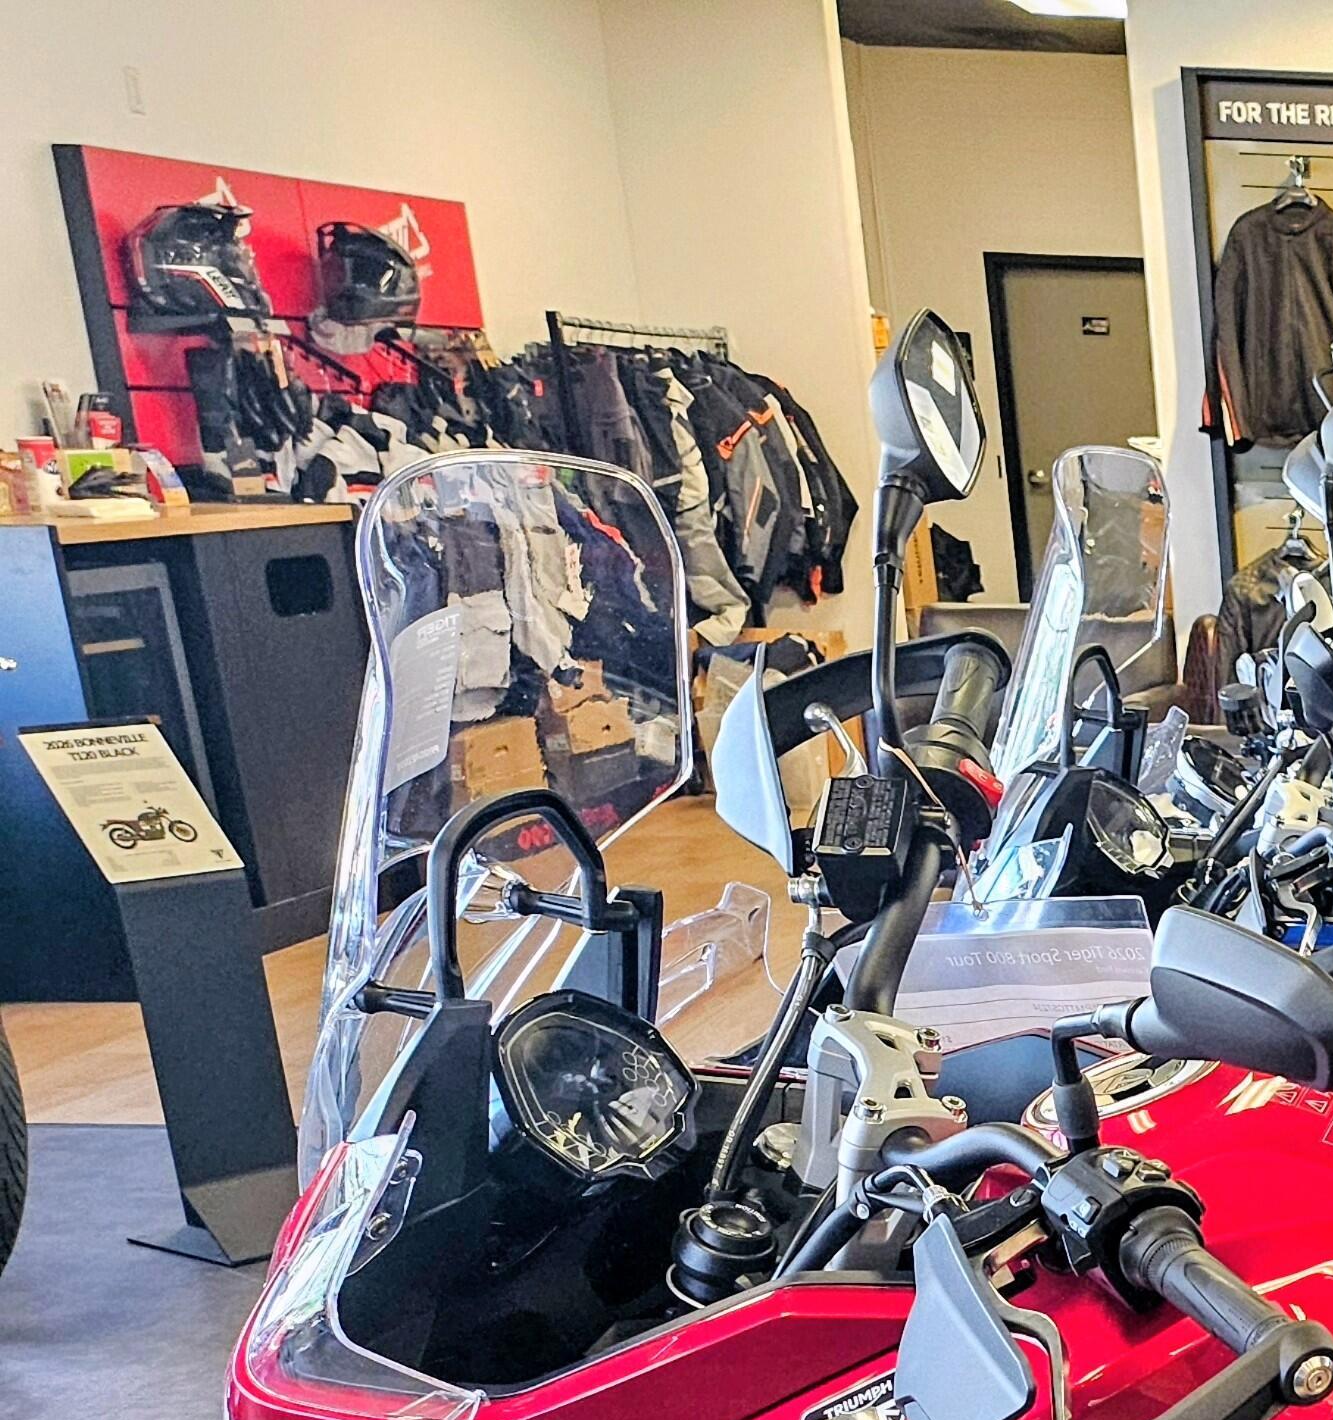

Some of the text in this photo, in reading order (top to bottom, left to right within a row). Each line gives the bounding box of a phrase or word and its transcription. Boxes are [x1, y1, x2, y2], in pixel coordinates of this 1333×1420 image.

[1218, 100, 1262, 124] FOR
[1265, 102, 1310, 125] THE
[73, 733, 148, 749] BONNEVILLE
[99, 746, 140, 759] BLACK
[822, 1379, 894, 1420] TRIUMPH
